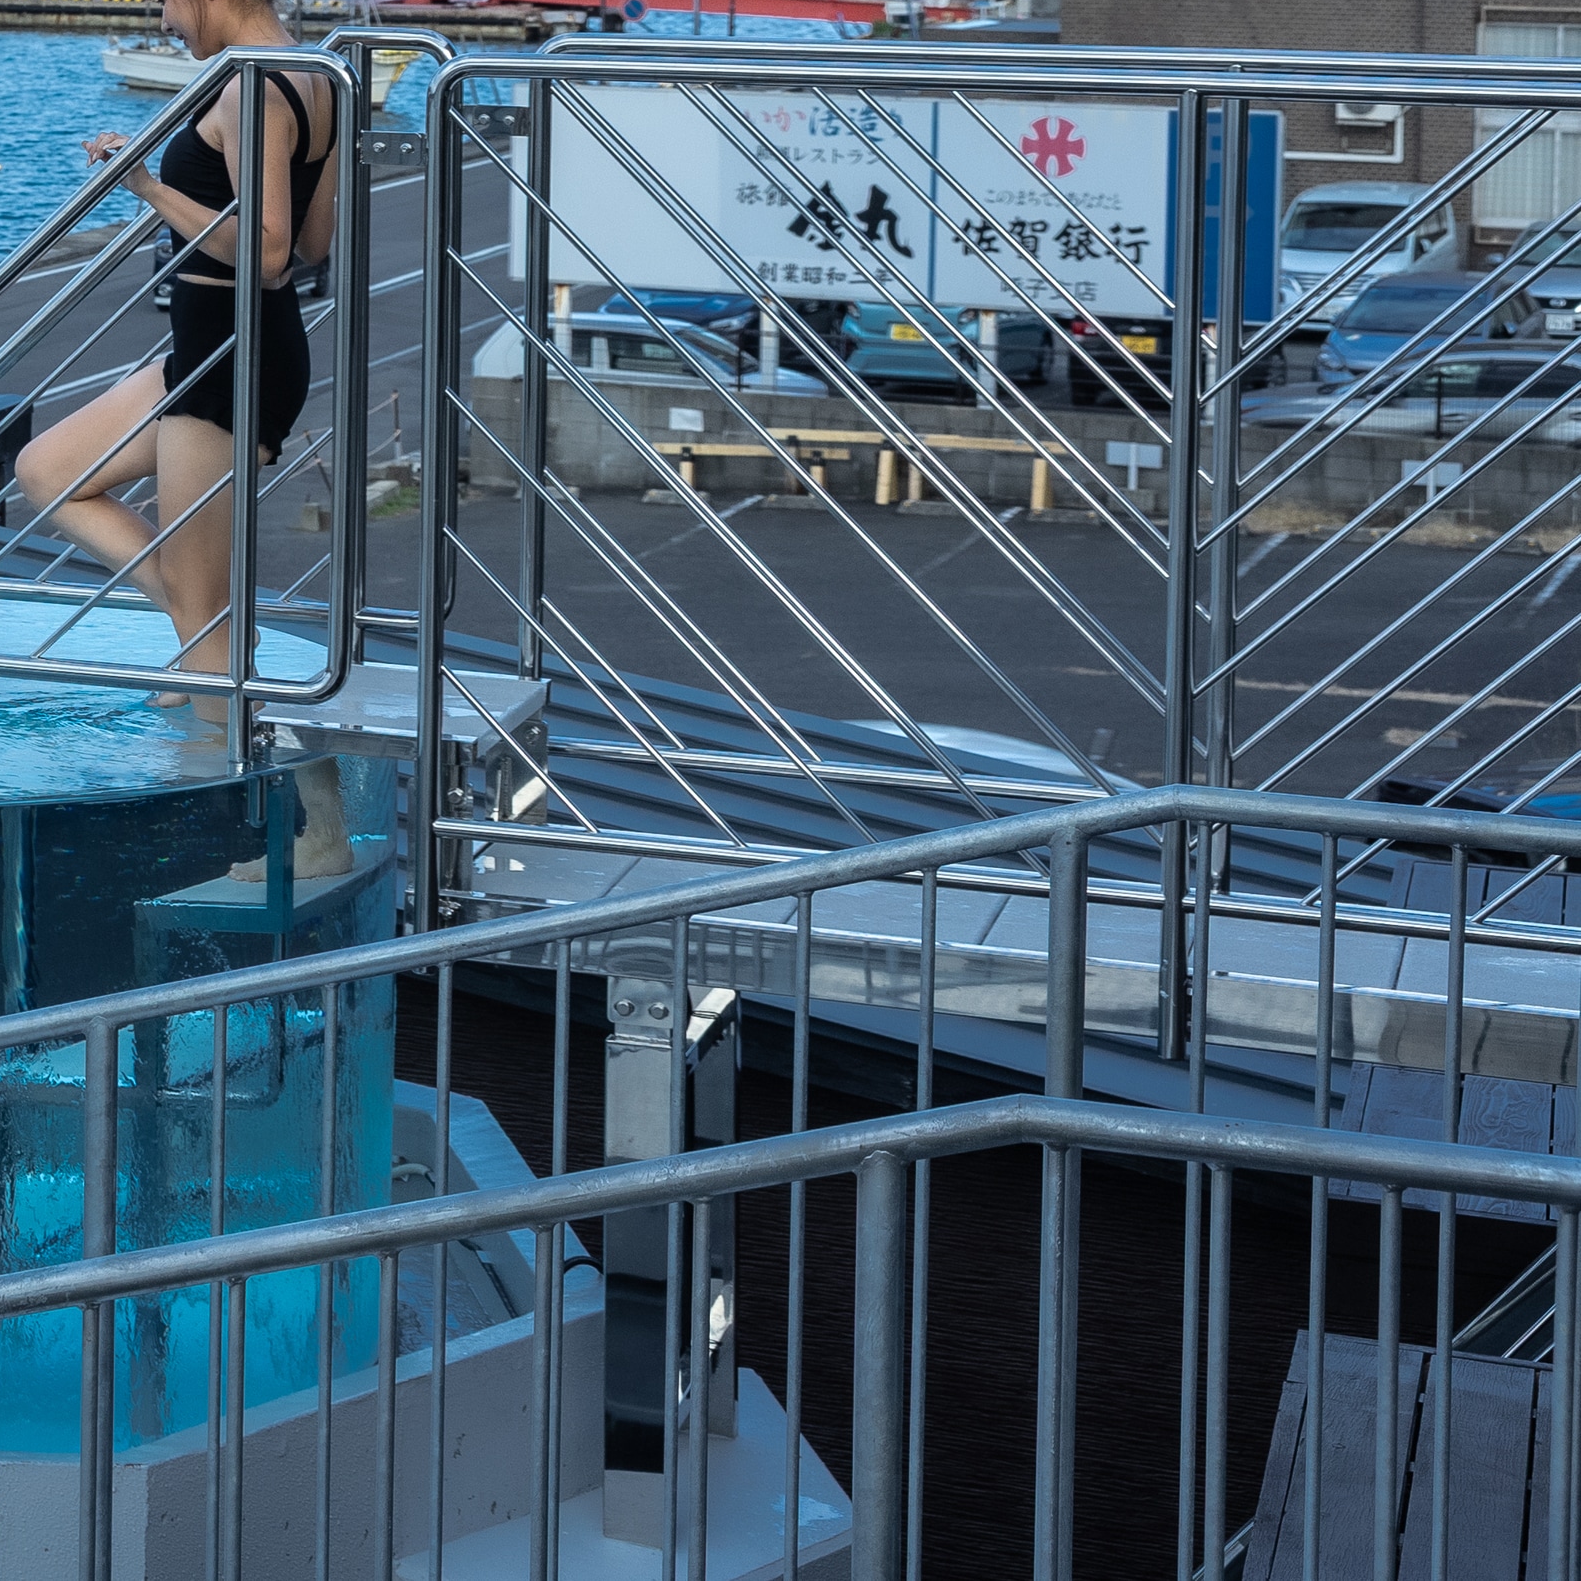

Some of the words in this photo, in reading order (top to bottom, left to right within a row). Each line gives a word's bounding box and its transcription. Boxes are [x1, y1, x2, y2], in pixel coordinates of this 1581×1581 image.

[736, 182, 794, 207] 旅館
[953, 216, 1151, 266] 佐賀銀行
[757, 261, 894, 287] 創業昭和二年
